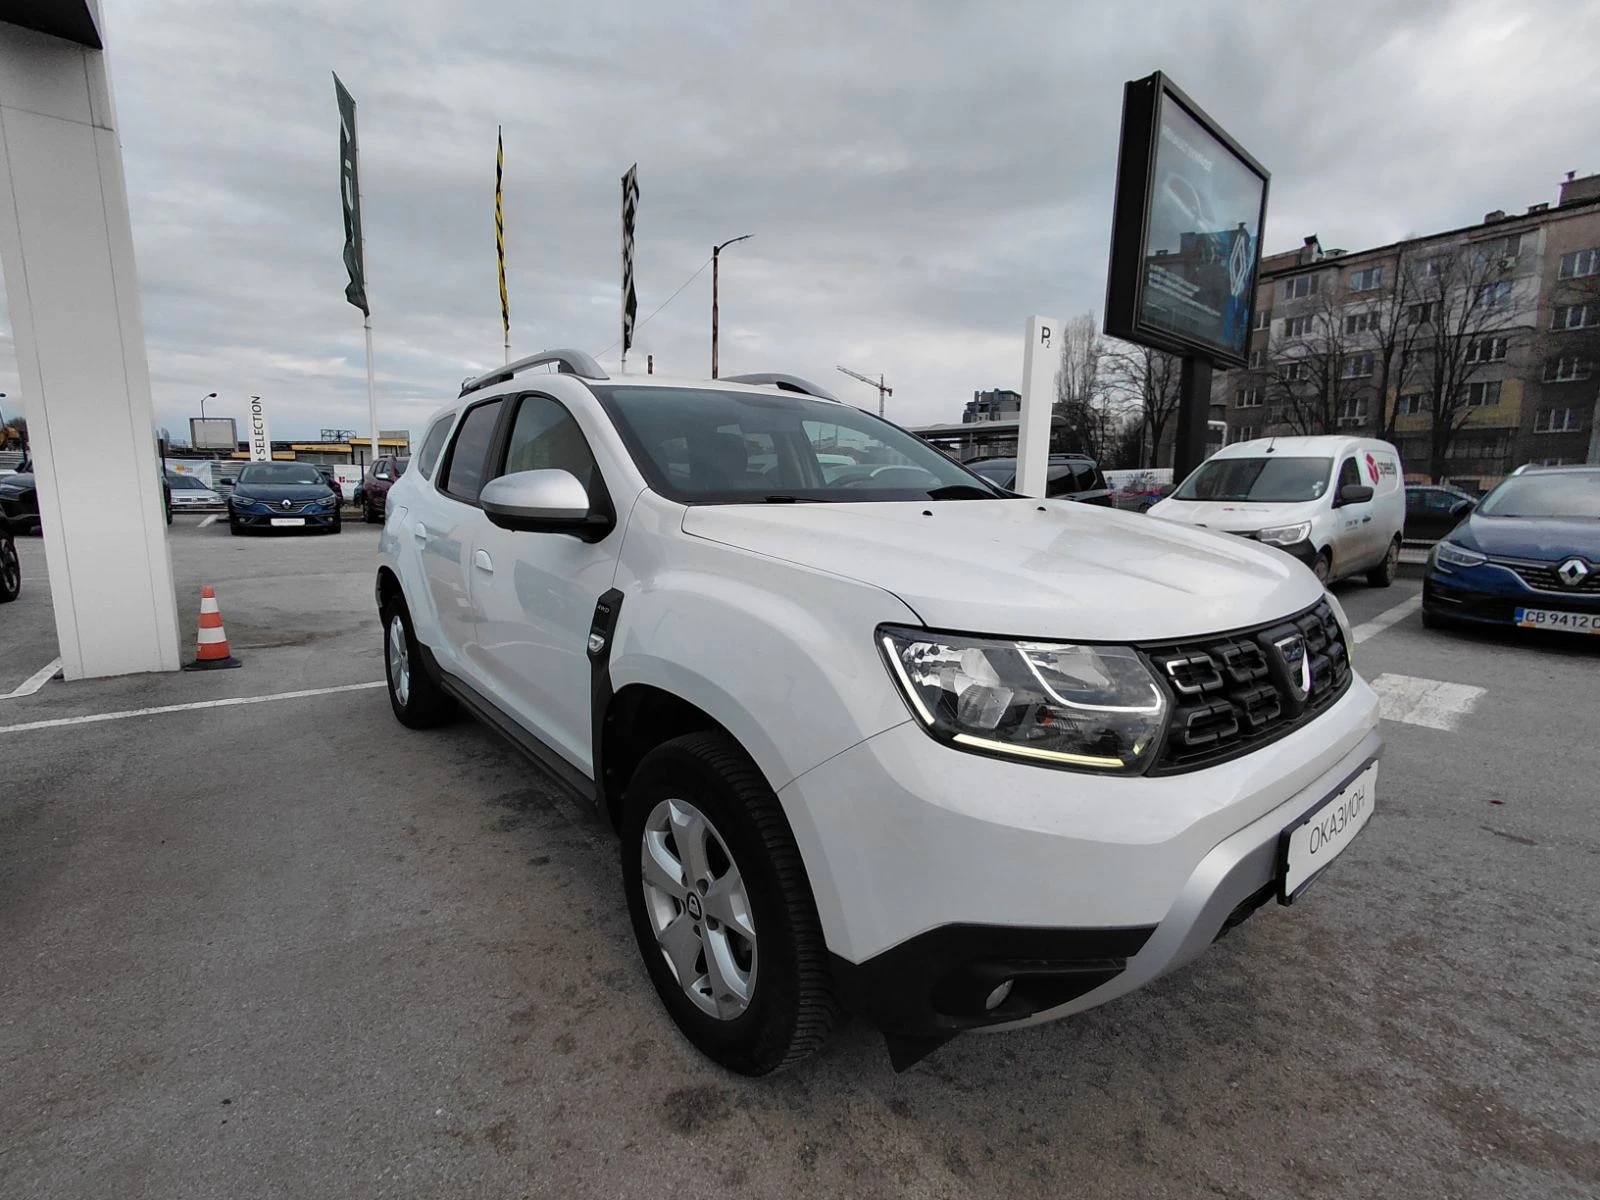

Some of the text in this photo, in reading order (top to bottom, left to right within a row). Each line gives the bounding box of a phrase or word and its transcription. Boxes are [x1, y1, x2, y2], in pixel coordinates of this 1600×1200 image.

[250, 395, 266, 455] SELECTION
[1525, 610, 1546, 624] CB
[1549, 613, 1589, 628] 9412
[1309, 784, 1365, 855] ОКАЗИОН
